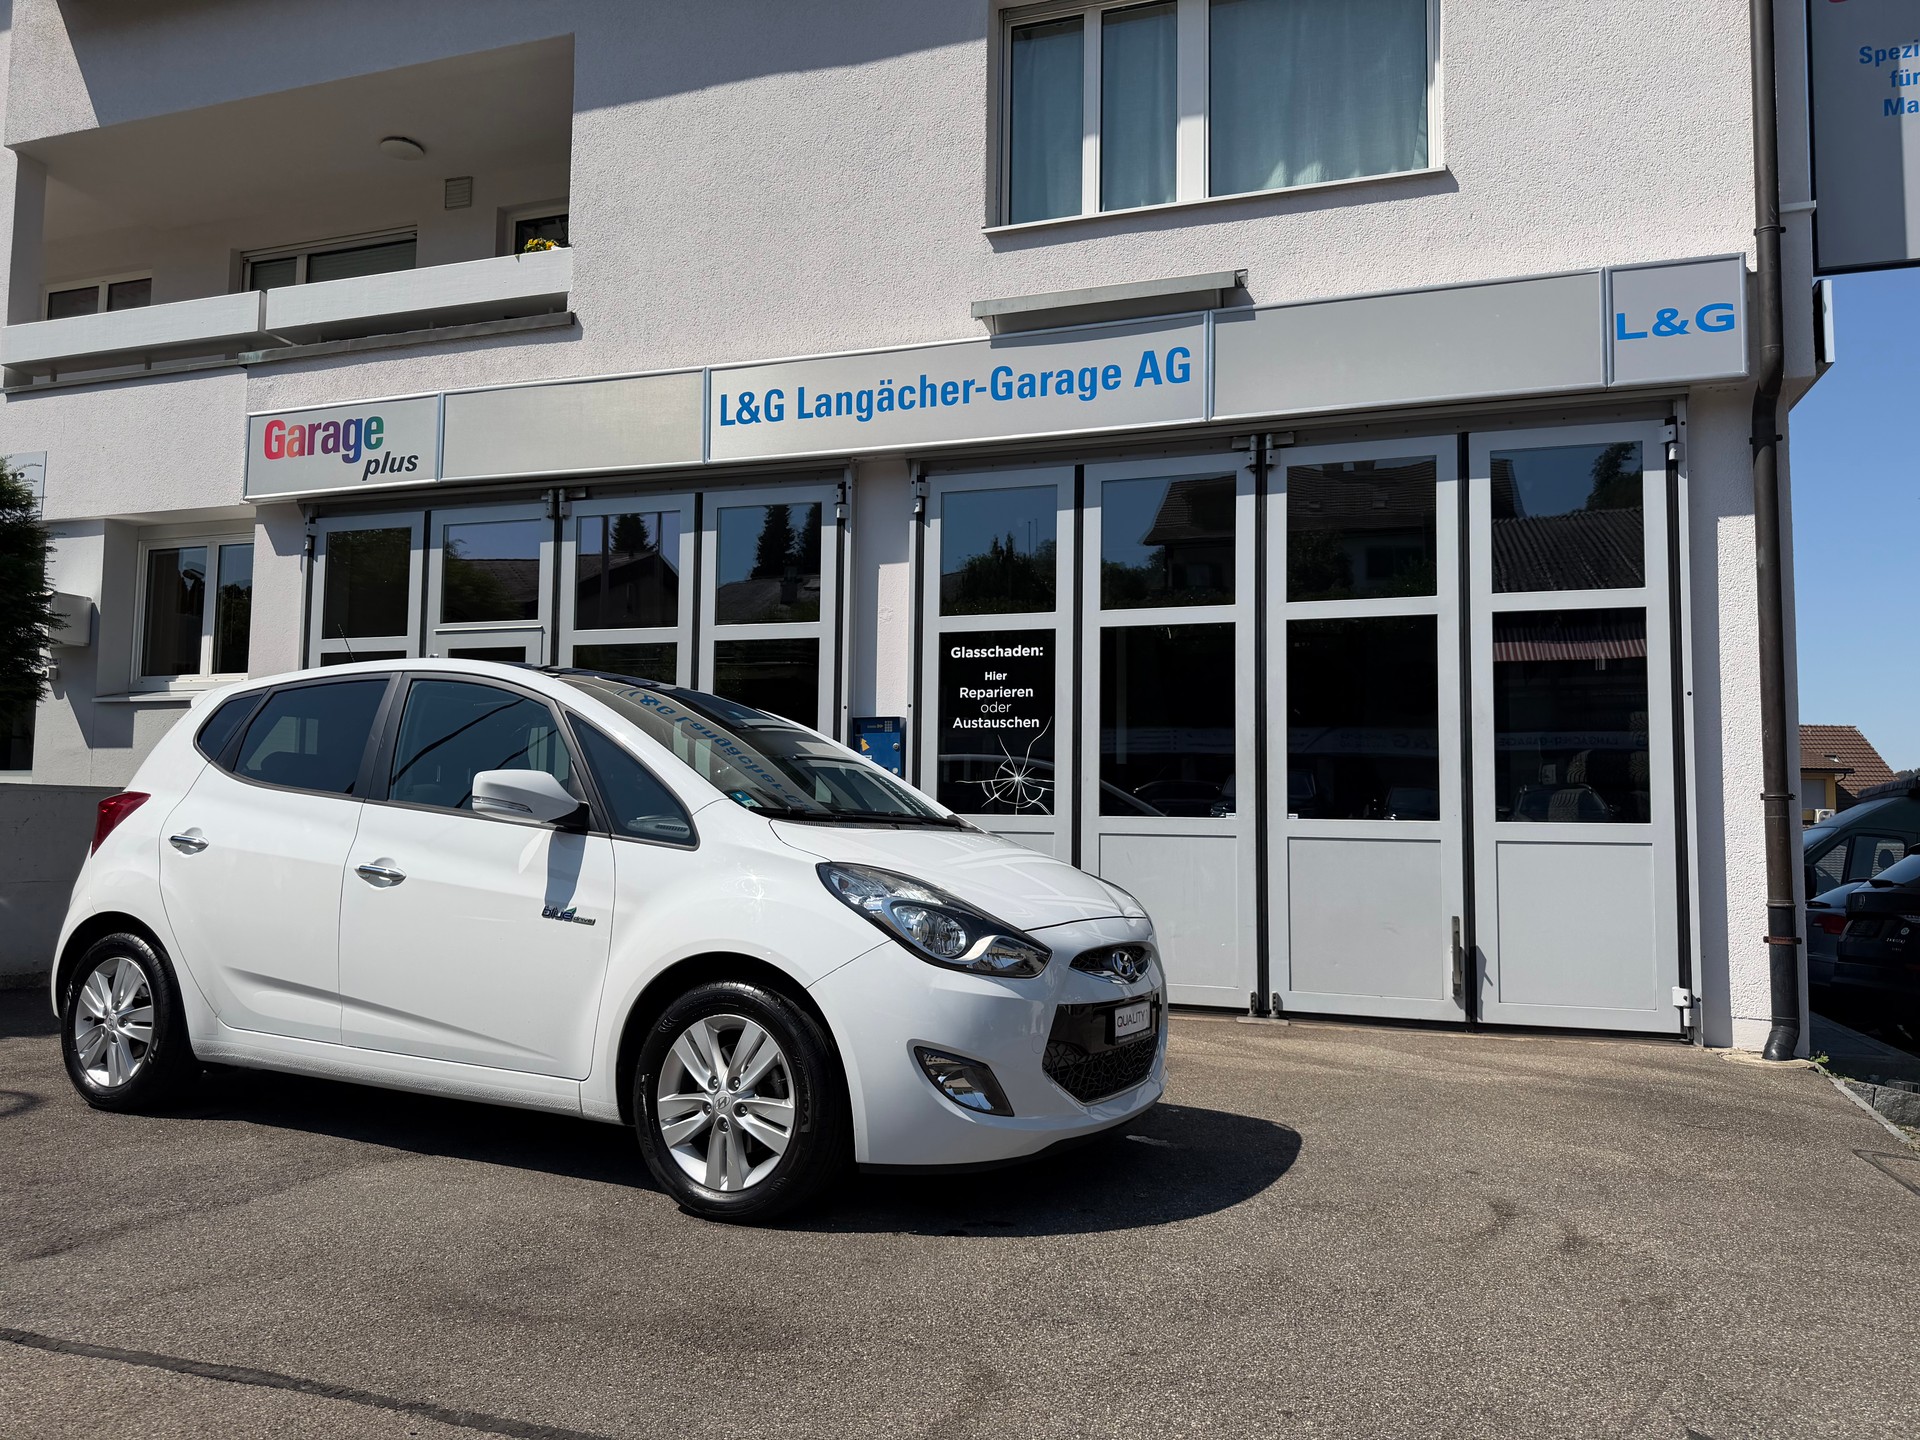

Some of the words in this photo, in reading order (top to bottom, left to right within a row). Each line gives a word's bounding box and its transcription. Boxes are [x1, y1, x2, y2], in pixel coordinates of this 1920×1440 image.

[1859, 39, 1919, 67] Spezi
[1889, 69, 1920, 88] für
[1616, 302, 1735, 341] L&G
[720, 389, 785, 427] L&G
[797, 361, 1122, 422] Langächer-Garage
[1133, 346, 1192, 388] AG
[264, 416, 384, 464] Garage
[361, 450, 419, 482] plus
[950, 645, 1044, 659] Glasschaden:
[984, 671, 1007, 681] Hier
[959, 686, 1034, 700] Reparieren
[980, 701, 1012, 713] oder
[952, 716, 1040, 729] Austauschen
